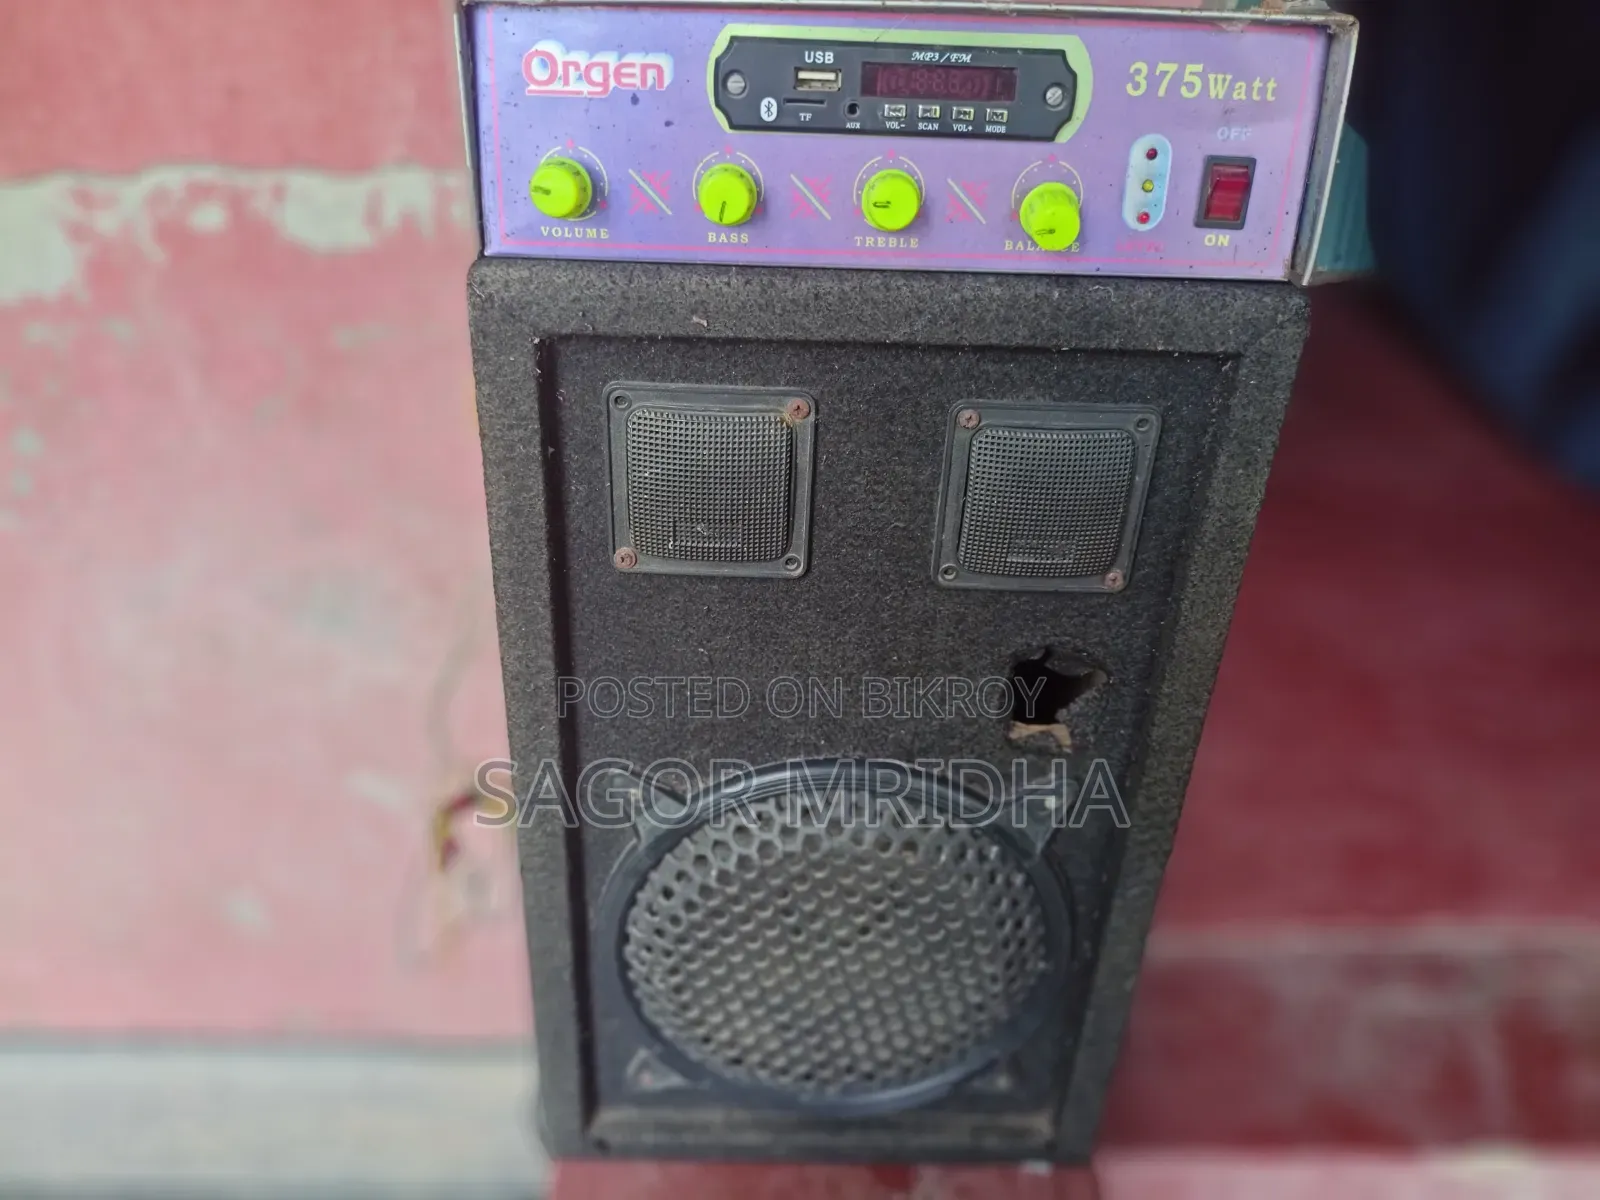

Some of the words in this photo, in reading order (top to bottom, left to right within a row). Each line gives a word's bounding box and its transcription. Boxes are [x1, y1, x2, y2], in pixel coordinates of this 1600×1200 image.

[804, 50, 835, 64] USB
[521, 43, 672, 97] Orgen
[799, 112, 813, 122] TF
[845, 121, 861, 130] AUX
[917, 122, 940, 132] SCAN
[952, 123, 974, 132] VOL+
[984, 124, 1007, 134] MODE
[1217, 126, 1253, 142] OFF
[540, 226, 611, 240] VOLUME
[708, 231, 750, 245] BASS
[854, 235, 920, 249] TREBLE
[1004, 239, 1081, 253] BALE
[1204, 233, 1231, 248] ON
